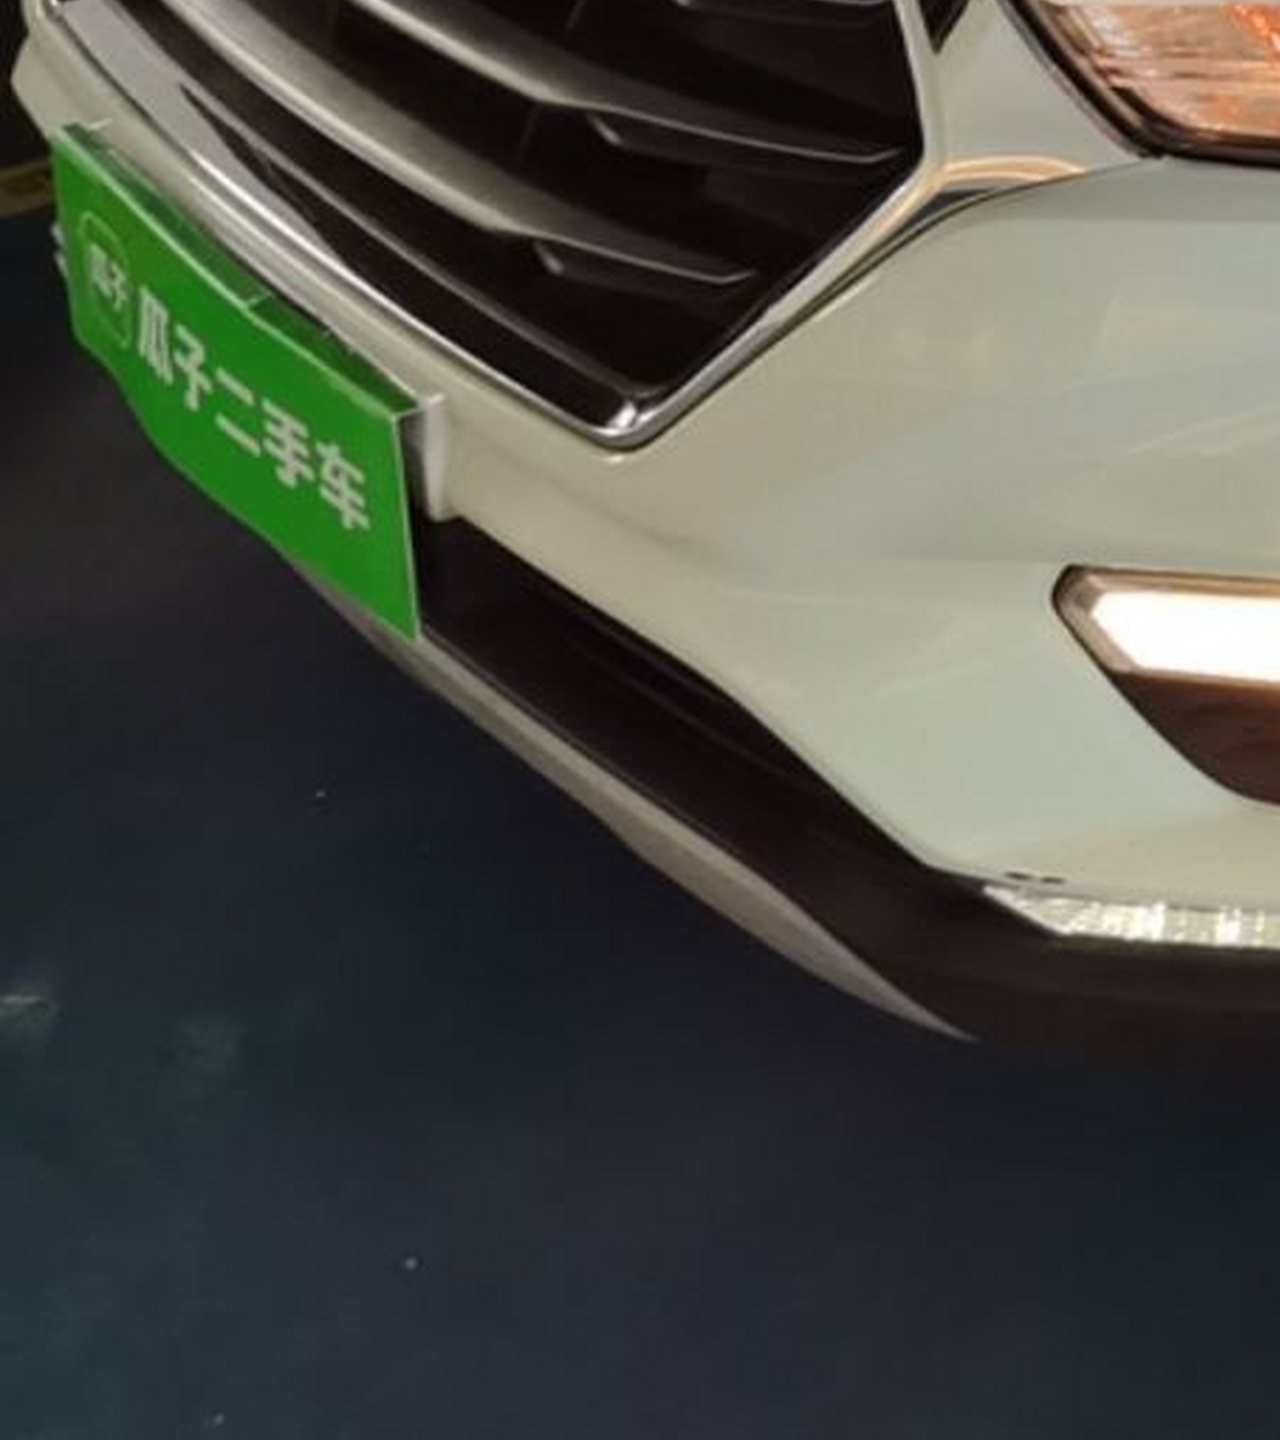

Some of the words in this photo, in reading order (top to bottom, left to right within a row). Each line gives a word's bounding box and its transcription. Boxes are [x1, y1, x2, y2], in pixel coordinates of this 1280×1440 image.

[137, 285, 371, 530] 瓜子二手车
